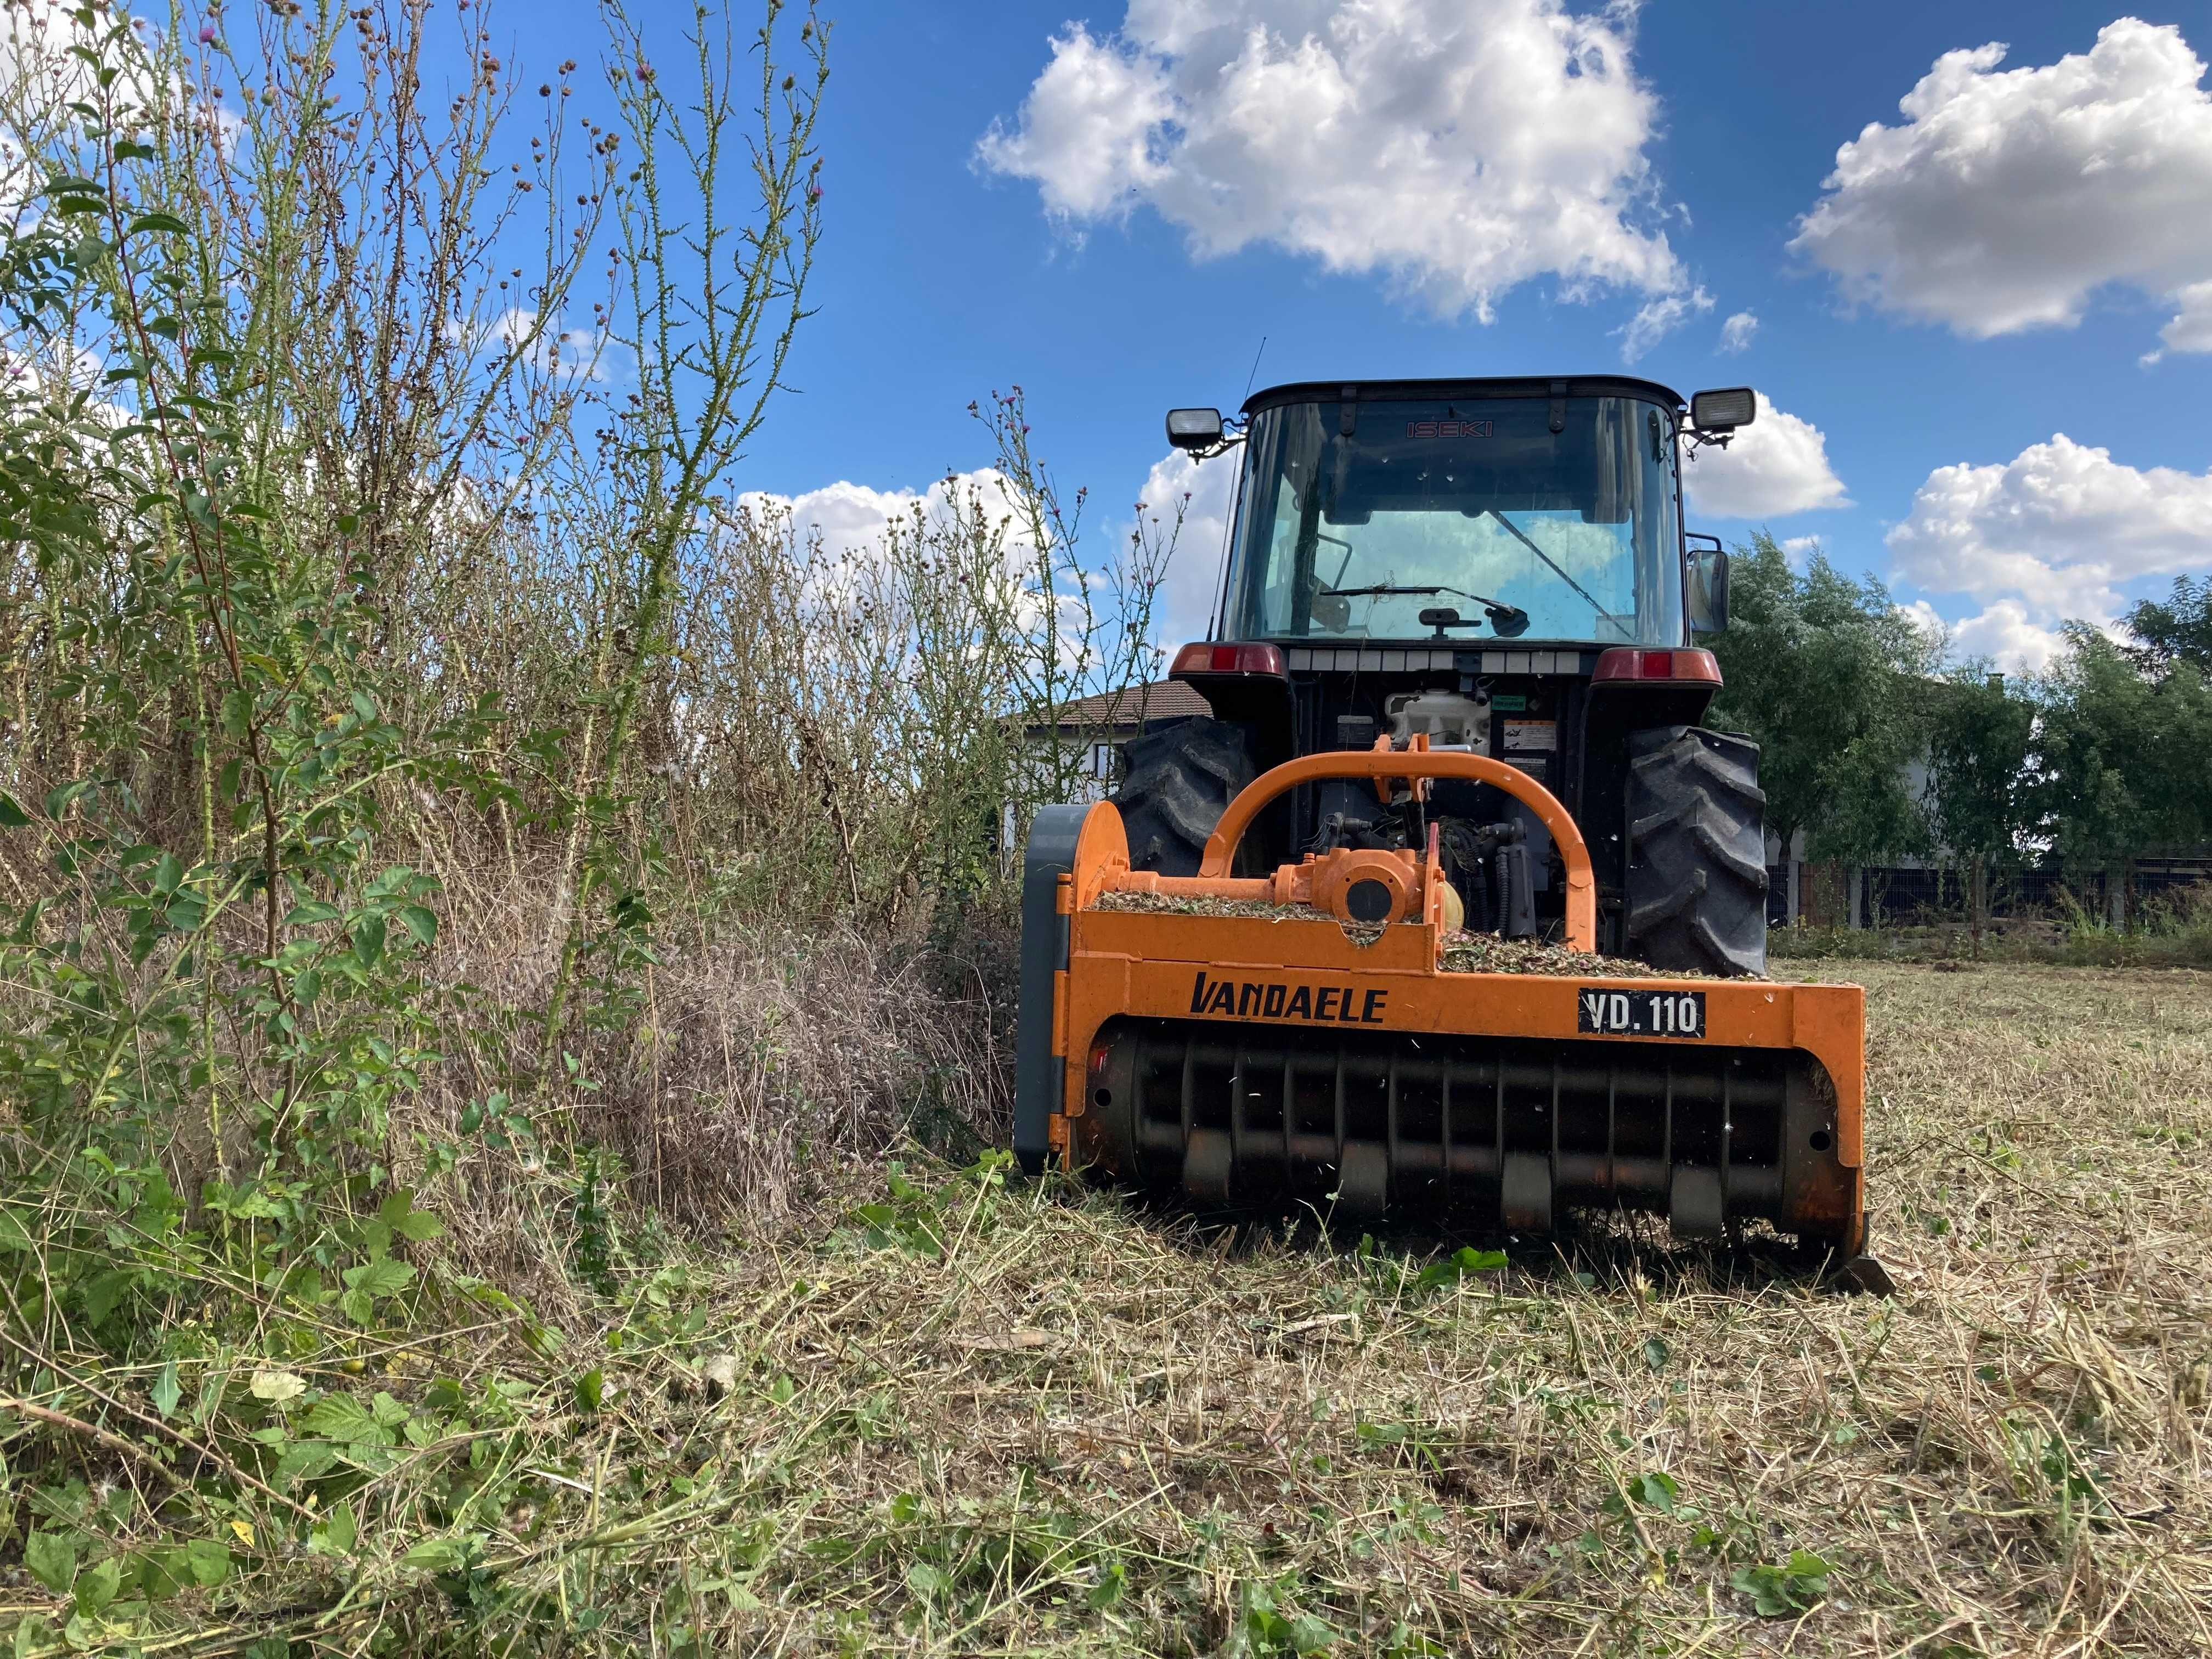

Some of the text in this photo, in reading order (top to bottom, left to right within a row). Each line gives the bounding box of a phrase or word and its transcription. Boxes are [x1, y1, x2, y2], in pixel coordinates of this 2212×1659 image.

[1407, 421, 1493, 438] ISEKI
[1190, 972, 1389, 1024] VANDAELE
[1587, 994, 1697, 1032] VD. 110
